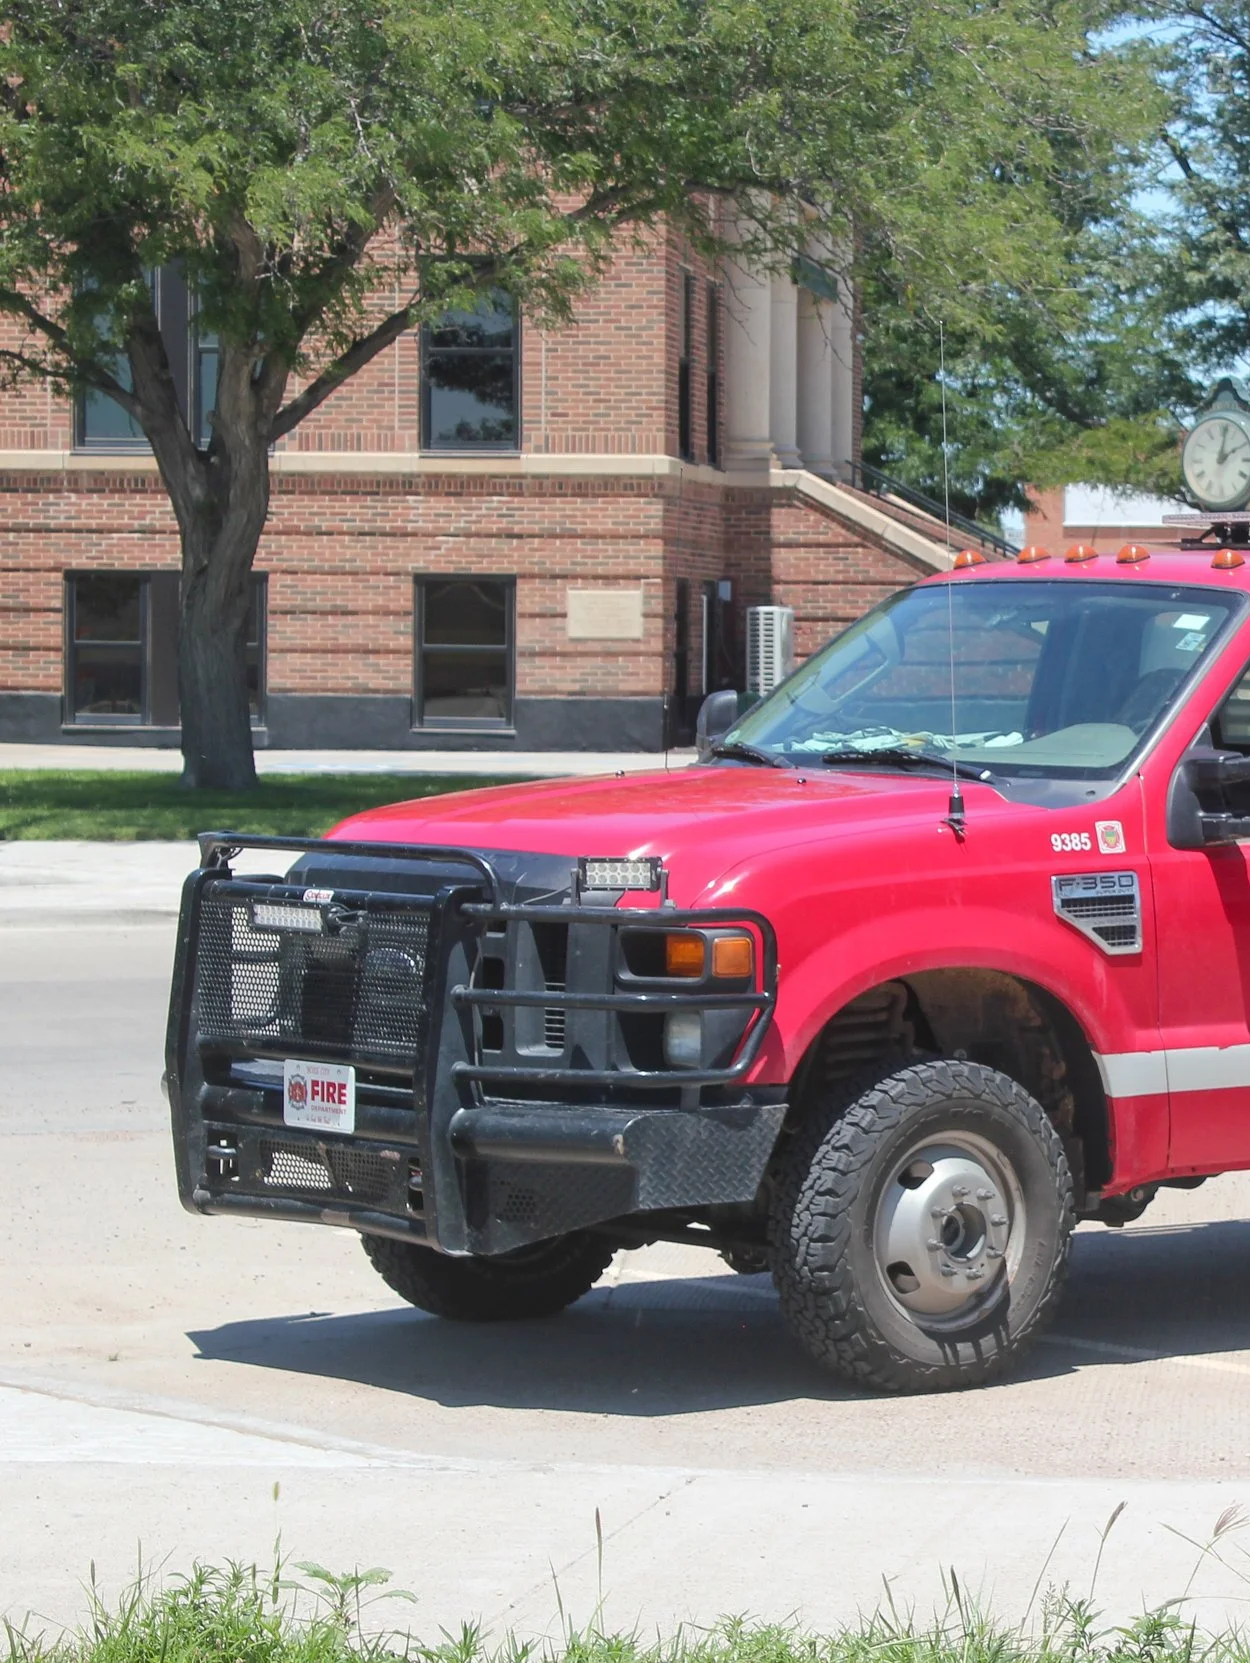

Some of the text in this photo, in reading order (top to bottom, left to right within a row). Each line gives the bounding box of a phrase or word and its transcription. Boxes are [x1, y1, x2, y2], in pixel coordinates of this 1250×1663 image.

[1051, 833, 1091, 852] 9385
[311, 1079, 346, 1105] FIRE
[311, 1105, 346, 1115] DEPARTMENT
